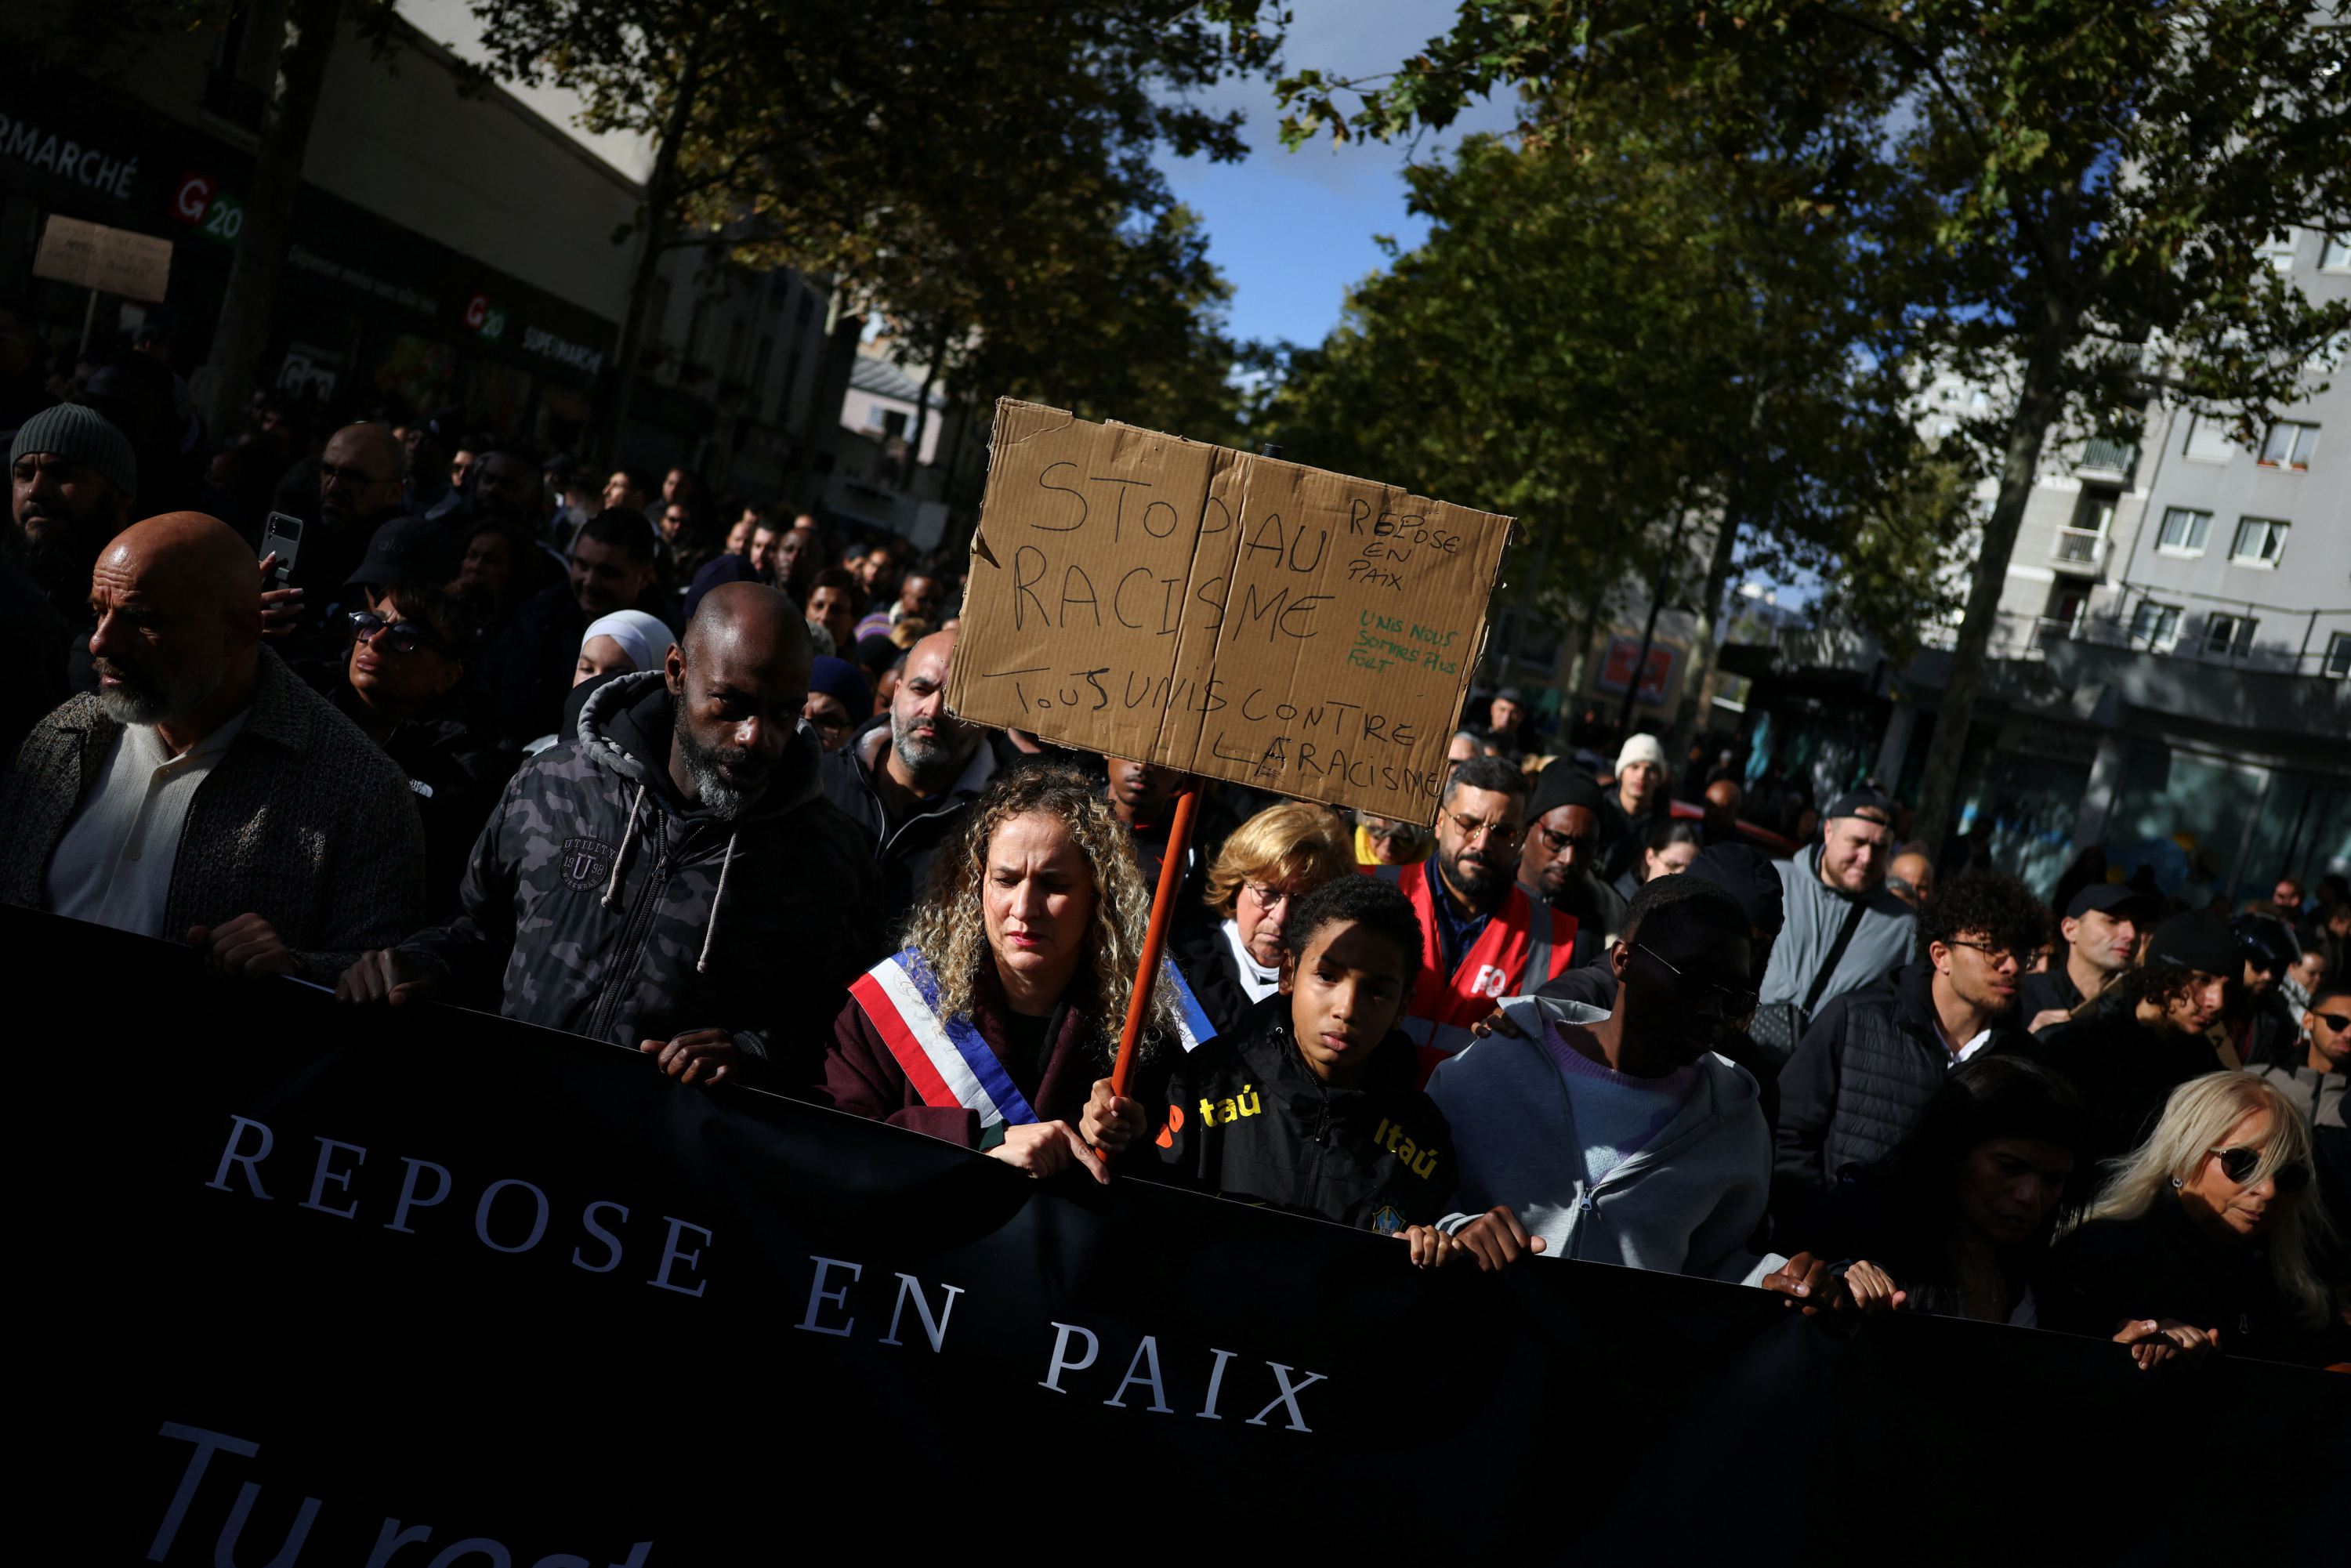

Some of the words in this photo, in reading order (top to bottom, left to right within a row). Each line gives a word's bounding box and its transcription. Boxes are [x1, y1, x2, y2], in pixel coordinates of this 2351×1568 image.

[1031, 462, 1231, 552] STOP
[1246, 513, 1327, 572] AU
[1349, 498, 1460, 553] REPOSE
[1362, 541, 1412, 563] EN
[1014, 545, 1335, 642] RACISME
[1409, 623, 1460, 647] NOUS
[1346, 648, 1395, 673] FORT
[1241, 688, 1415, 746] CONTRE
[564, 838, 616, 860] UTILITY
[561, 871, 598, 890] WORKWEAR
[1470, 964, 1506, 998] FO
[1199, 1084, 1262, 1128] taú
[1373, 1117, 1440, 1180] Itaú
[1382, 1227, 1392, 1236] CBF
[204, 1113, 714, 1299] REPOSE
[792, 1255, 966, 1354] EN
[1036, 1320, 1329, 1434] PAIX
[145, 1420, 324, 1568] Tu
